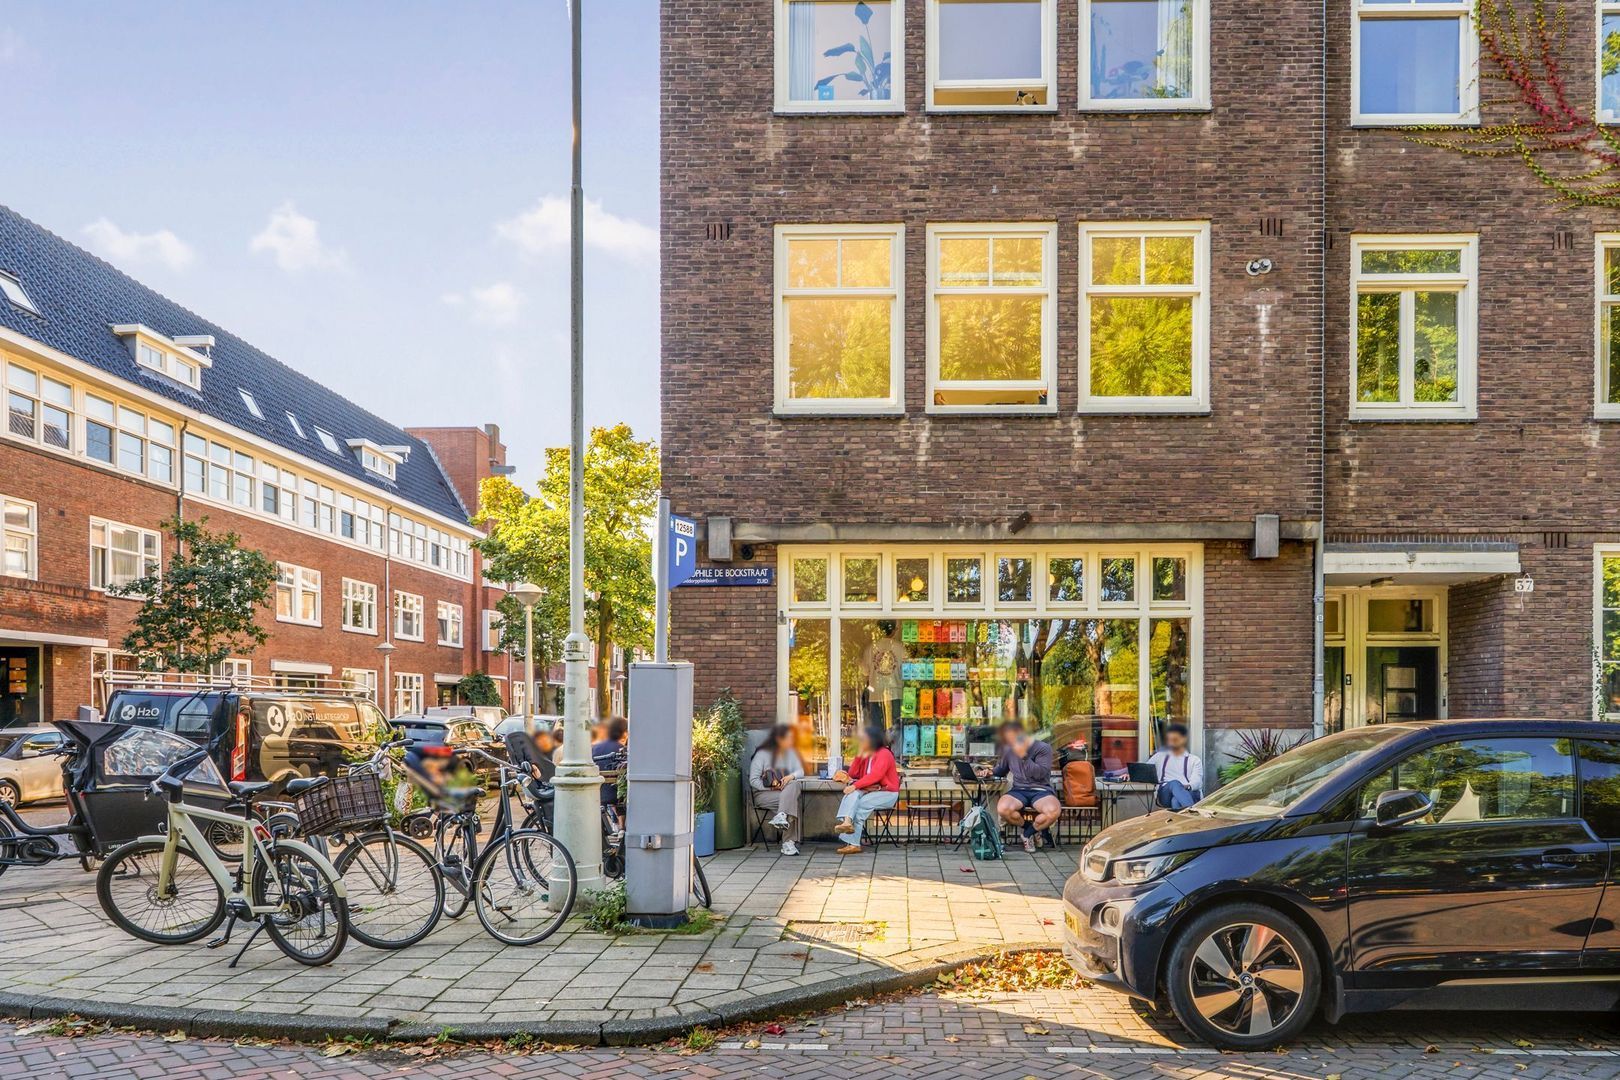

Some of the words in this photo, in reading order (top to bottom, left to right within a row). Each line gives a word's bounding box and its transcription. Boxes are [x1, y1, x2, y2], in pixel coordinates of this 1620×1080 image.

[676, 523, 693, 535] 12588
[675, 537, 688, 566] P
[714, 568, 724, 578] DE
[725, 568, 768, 578] BOCKSTRAAT
[1516, 579, 1533, 591] 37
[137, 707, 160, 717] H2O
[286, 709, 303, 722] H2O
